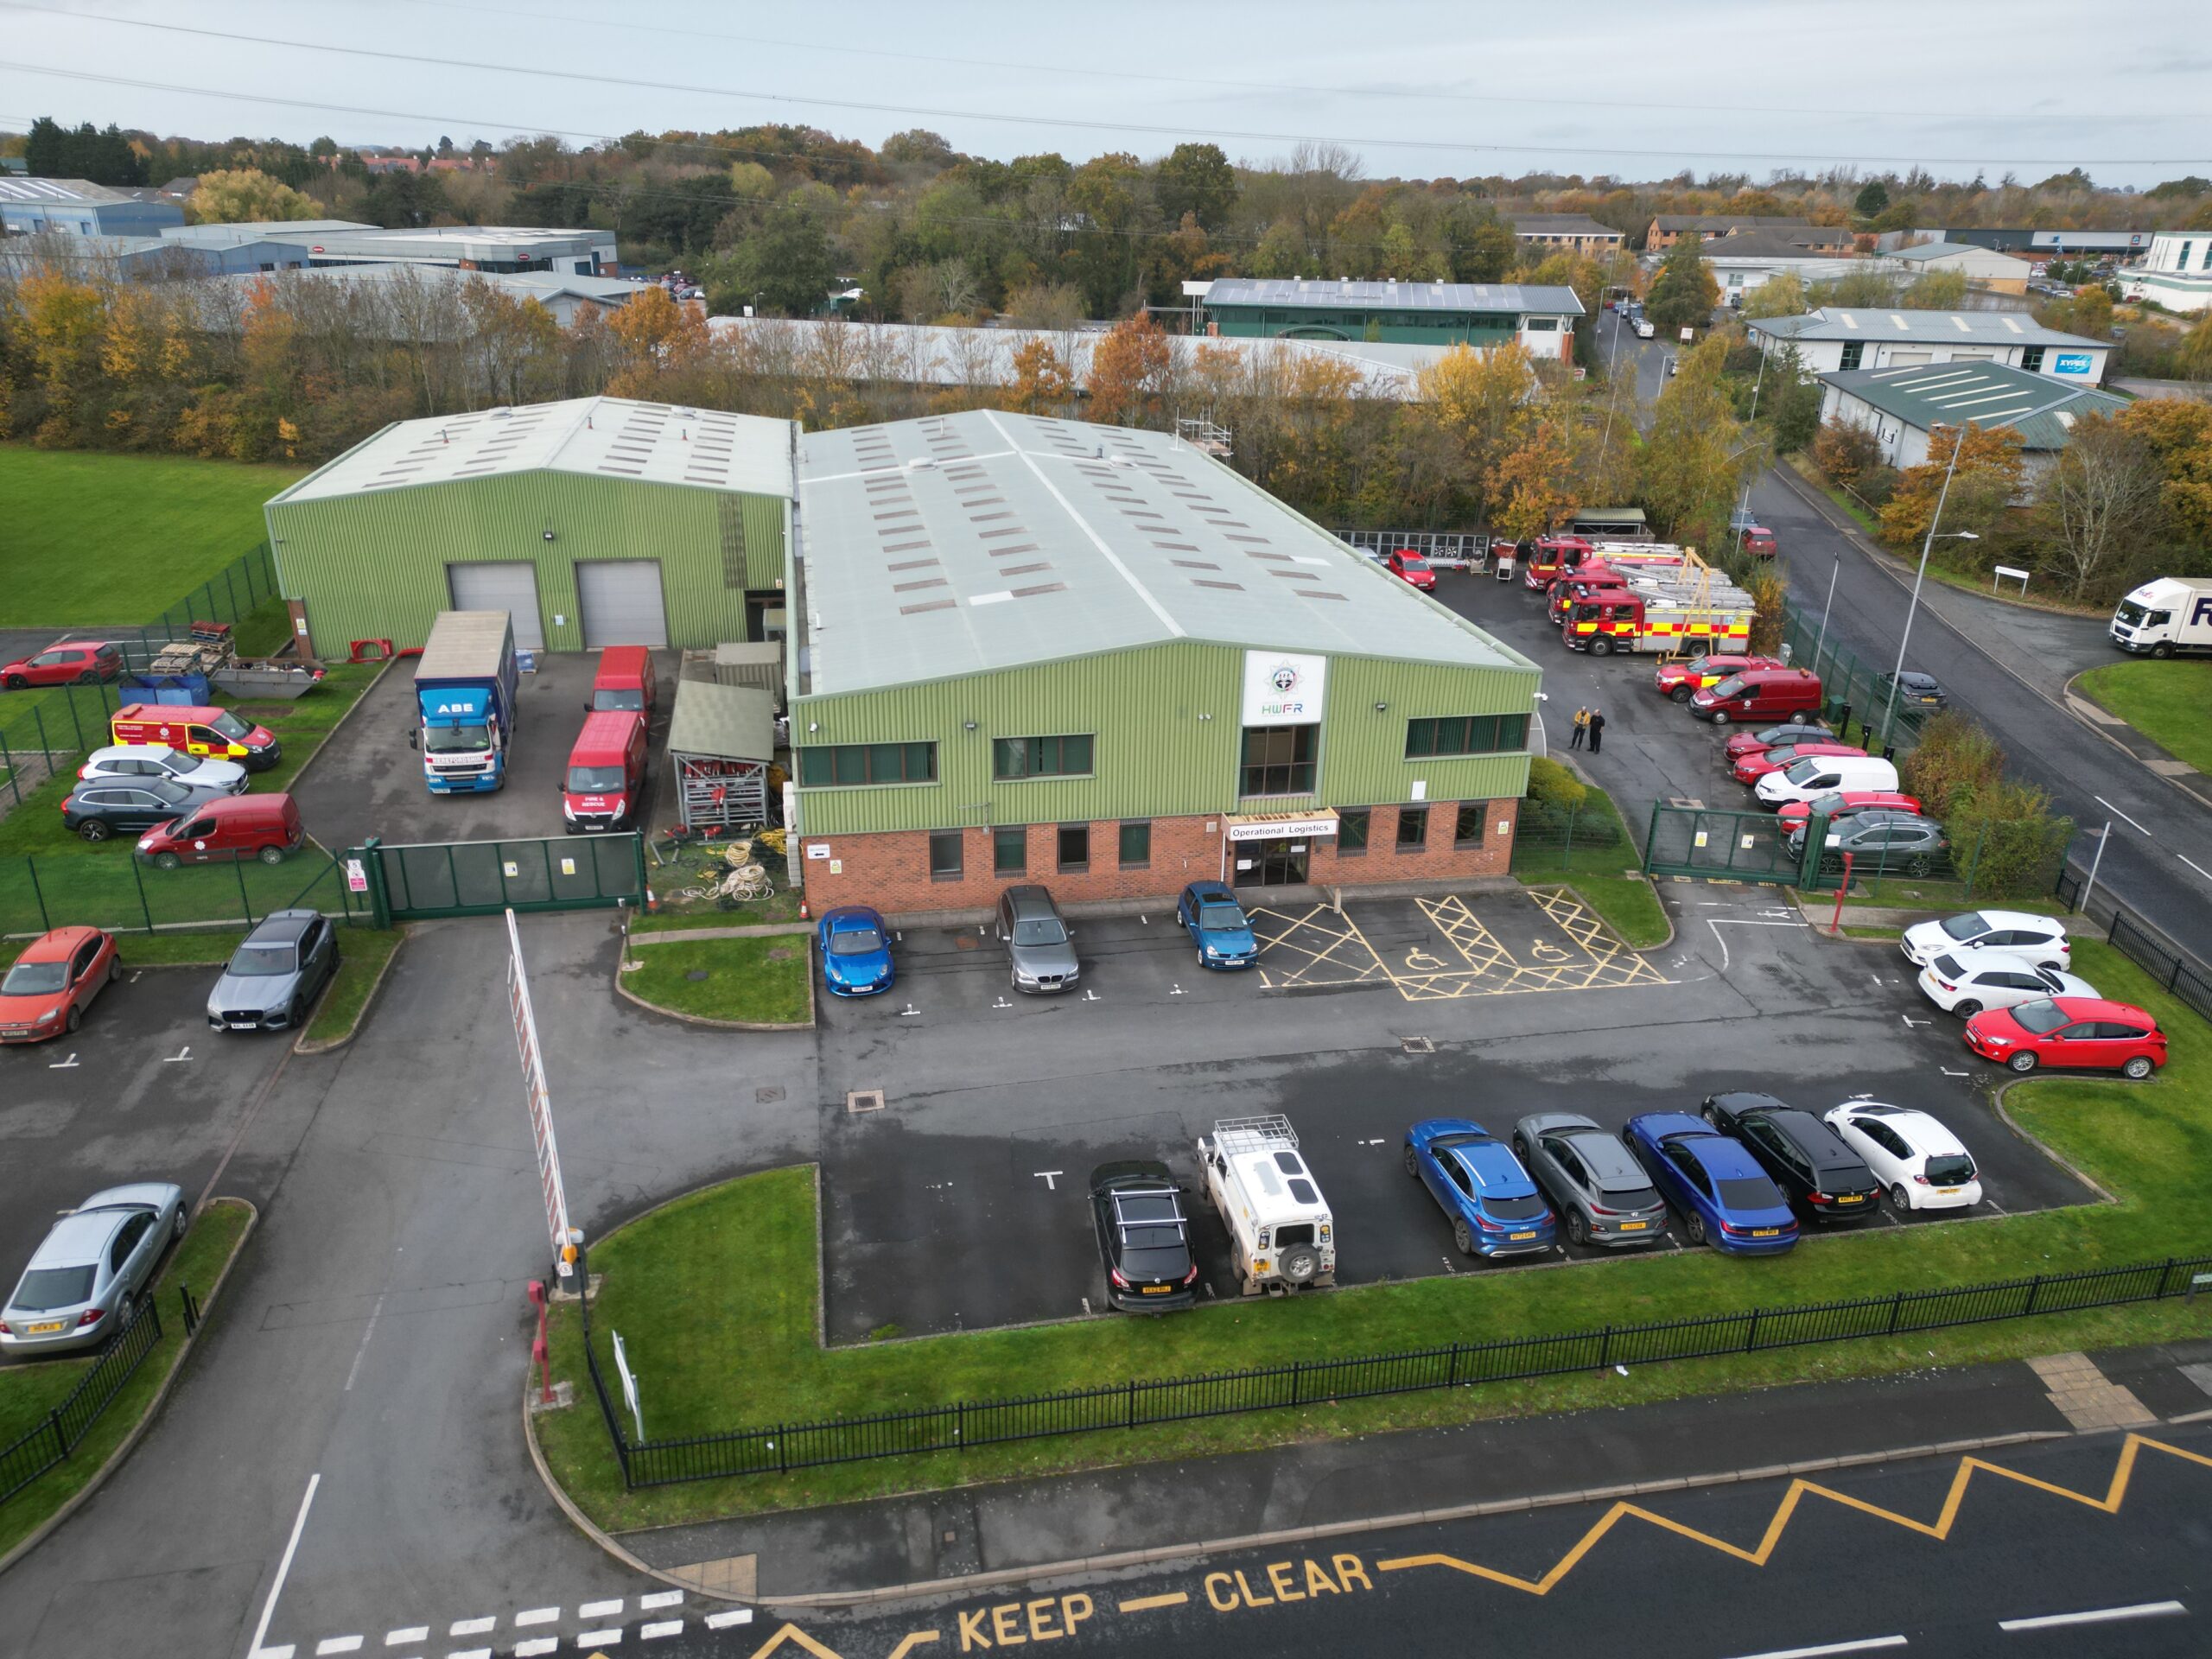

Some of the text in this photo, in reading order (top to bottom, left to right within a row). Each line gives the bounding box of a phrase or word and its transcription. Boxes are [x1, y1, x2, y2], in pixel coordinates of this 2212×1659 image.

[2190, 597, 2212, 626] F
[438, 703, 474, 713] ABE
[1262, 703, 1303, 714] HWFR
[1232, 824, 1329, 837] Operational Logistics
[958, 1554, 1373, 1651] KEEP CLEAR
